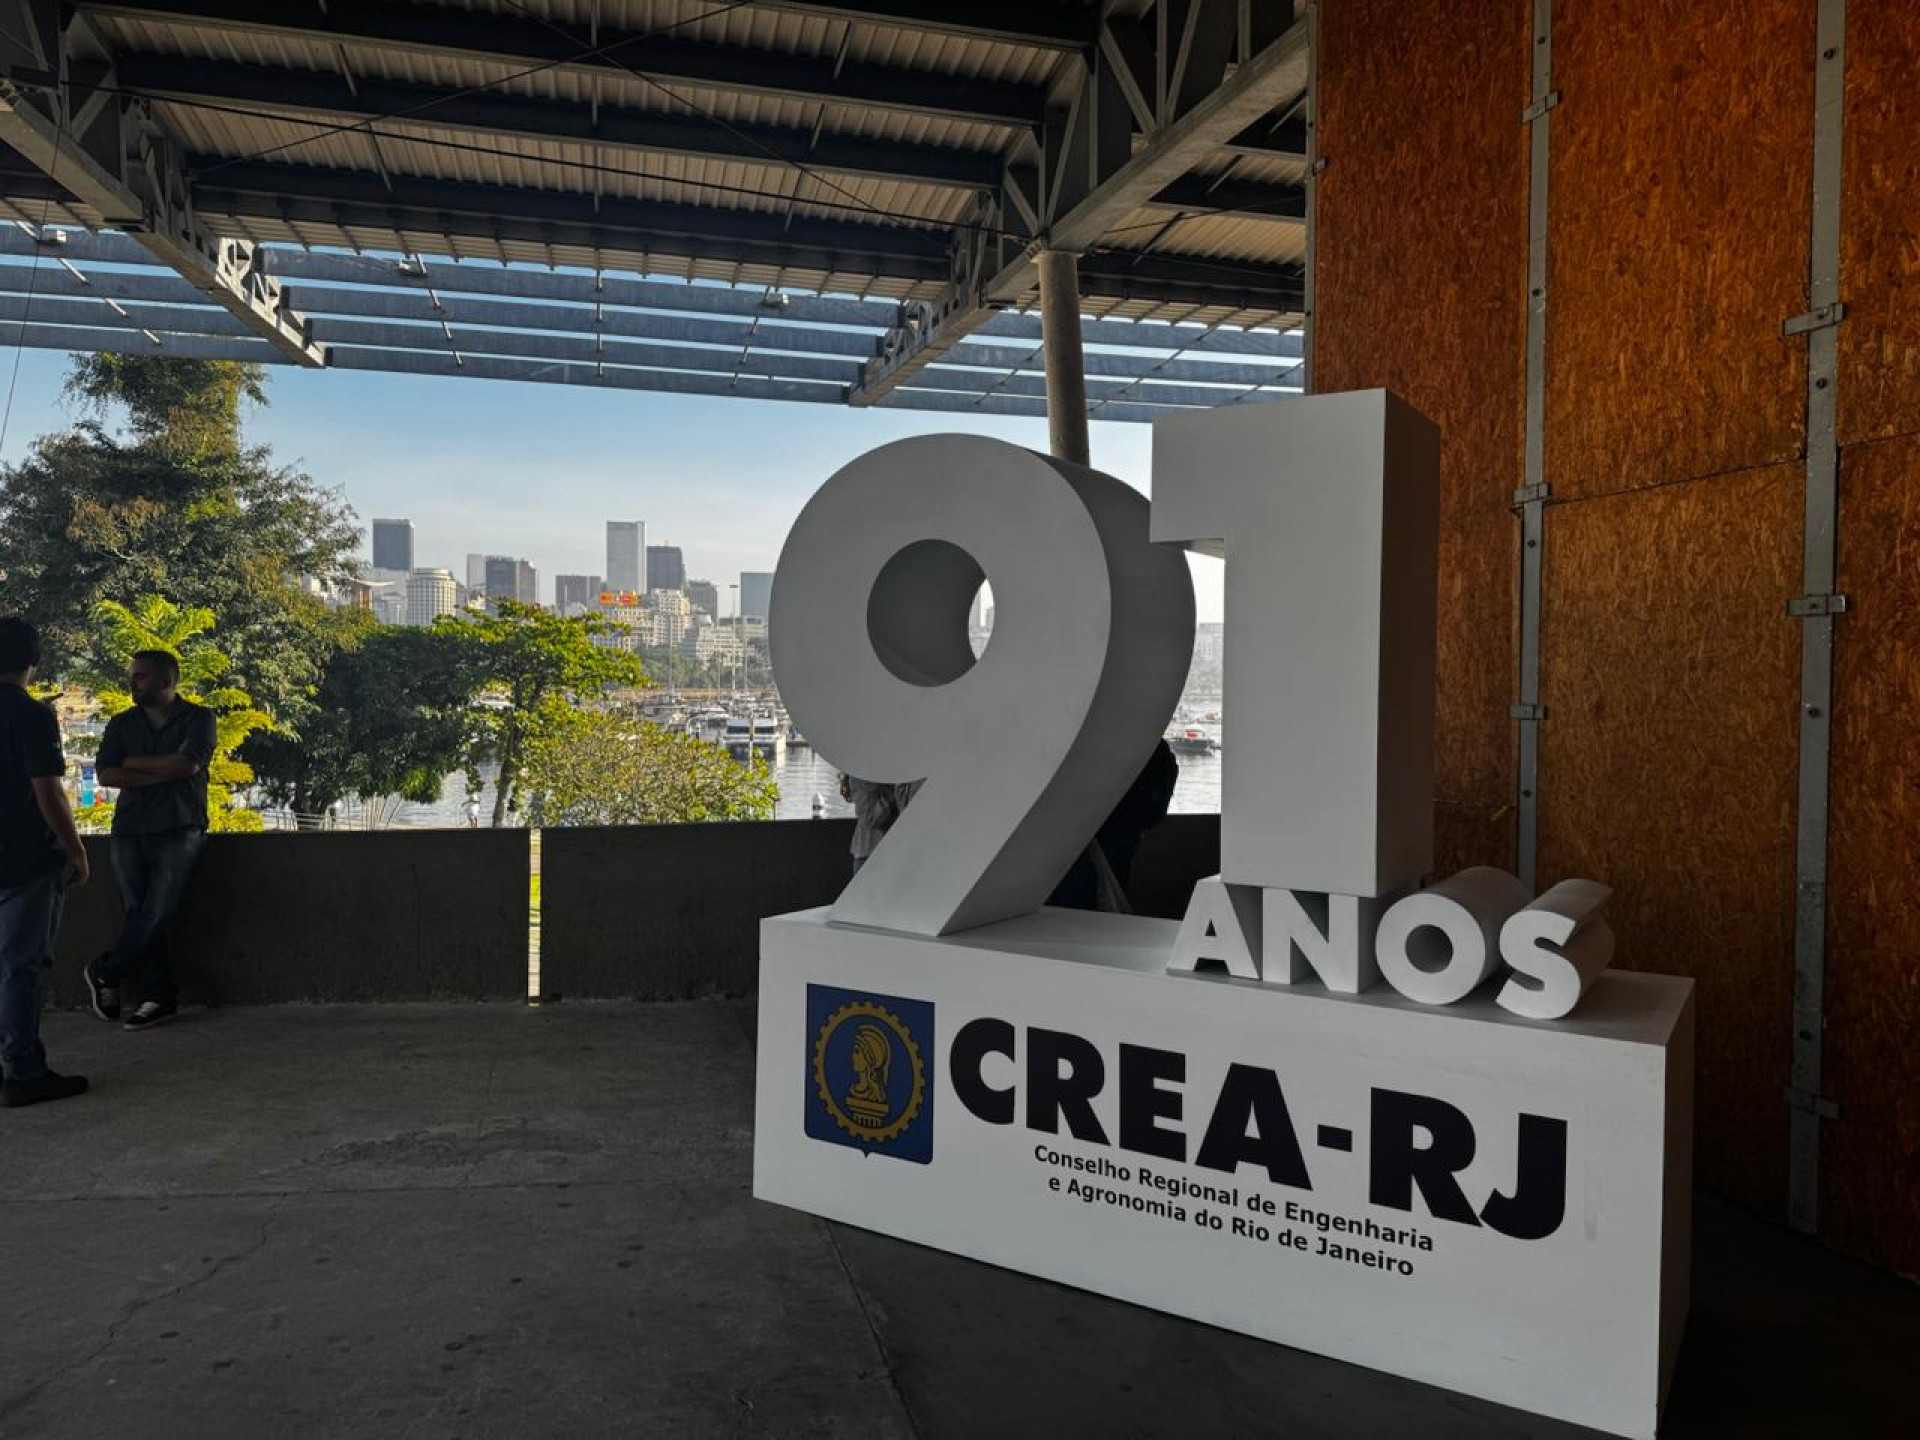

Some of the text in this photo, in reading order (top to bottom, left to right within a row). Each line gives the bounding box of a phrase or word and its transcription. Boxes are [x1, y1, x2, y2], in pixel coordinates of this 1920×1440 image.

[769, 388, 1390, 938] 91
[1166, 874, 1586, 1020] ANOS
[949, 1017, 1568, 1240] CREA-RJ
[1034, 1145, 1433, 1252] Conselho Regional de Engenharia
[1049, 1177, 1414, 1276] e Agronomia do Rio de Janeiro
